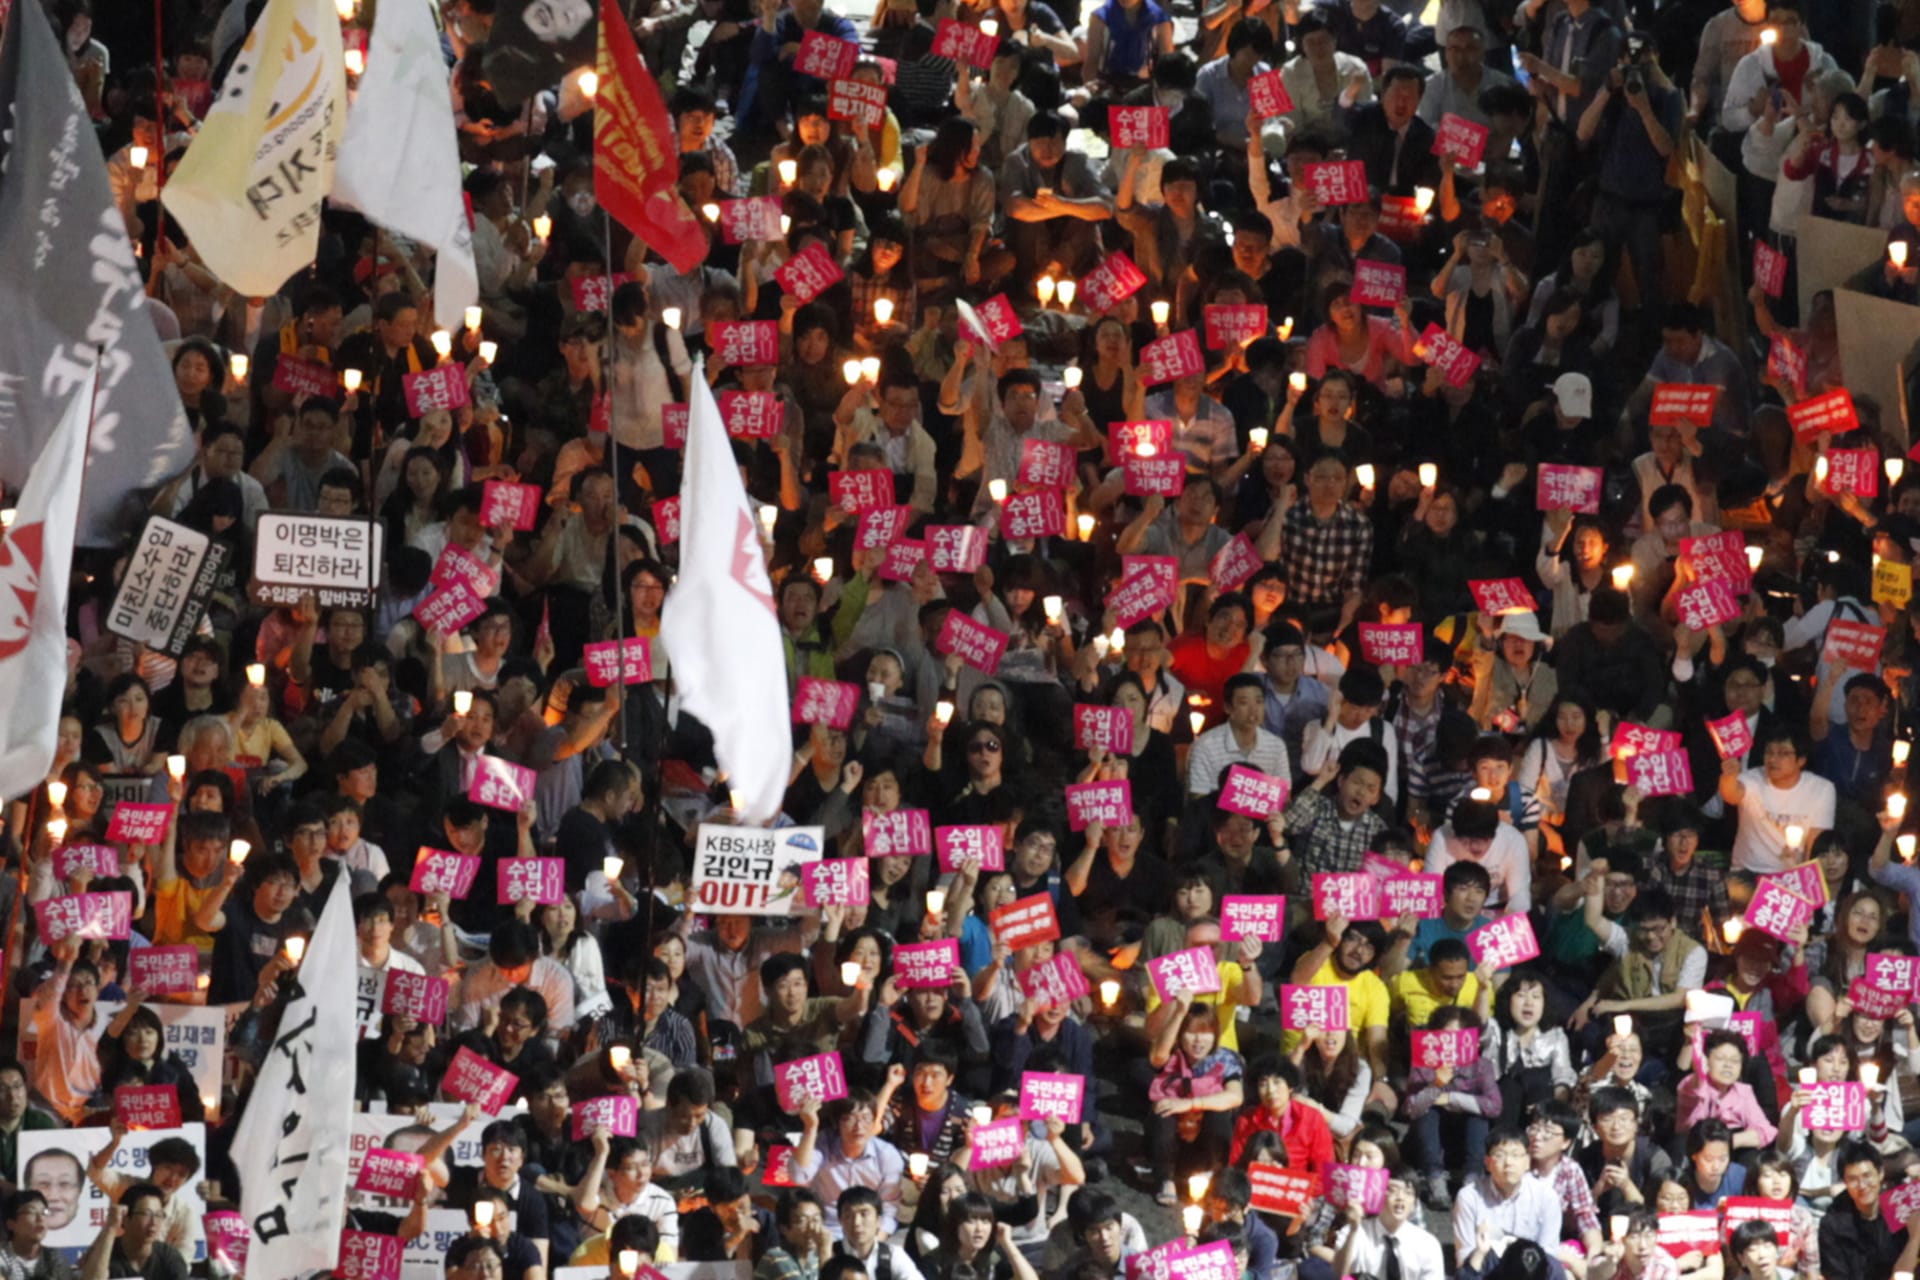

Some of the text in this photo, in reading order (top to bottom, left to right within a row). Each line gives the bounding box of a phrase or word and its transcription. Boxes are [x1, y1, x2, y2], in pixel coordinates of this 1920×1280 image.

[722, 324, 758, 345] 수입
[723, 345, 758, 363] 중단
[1147, 336, 1178, 361] 수입
[1151, 355, 1184, 380] 중단
[412, 372, 446, 392] 수입
[730, 394, 765, 415] 수입
[729, 415, 765, 434] 중단
[1031, 443, 1060, 464] 수입
[1832, 453, 1858, 473] 수입
[1030, 462, 1060, 486] 중단
[1129, 459, 1180, 474] 국민주권
[838, 473, 872, 495] 수입
[1135, 475, 1172, 490] 지켜요
[1006, 495, 1042, 517] 수입
[866, 509, 897, 530] 수입
[1010, 515, 1044, 537] 중단
[275, 523, 364, 551] 이명박은
[862, 527, 893, 548] 중단
[273, 555, 363, 580] 퇴진하라
[145, 545, 196, 631] 중단하라
[420, 583, 466, 620] 국민주권
[1679, 588, 1710, 612] 수입
[436, 599, 472, 631] 지켜요
[1684, 604, 1719, 630] 중단
[950, 619, 1000, 652] 국민주권
[1363, 629, 1416, 645] 국민주권
[948, 638, 986, 663] 지켜요
[1371, 645, 1409, 660] 지켜요
[1080, 709, 1111, 729] 수입
[1633, 752, 1668, 774] 수입
[1230, 773, 1282, 803] 국민주권
[1636, 772, 1671, 794] 중단
[1070, 785, 1122, 805] 국민주권
[1230, 792, 1269, 815] 지켜요
[117, 808, 167, 826] 국민주권
[1078, 803, 1117, 820] 지켜요
[119, 825, 154, 840] 지켜요
[872, 813, 909, 834] 수입
[873, 832, 910, 854] 중단
[946, 829, 983, 849] 수입
[427, 854, 461, 878] 수입
[506, 861, 542, 881] 수입
[703, 855, 774, 880] 김인규
[811, 862, 848, 884] 수입
[421, 873, 456, 893] 중단
[506, 879, 543, 900] 중단
[700, 880, 770, 908] OUT!
[812, 881, 849, 903] 중단
[1320, 877, 1356, 899] 수입
[1383, 880, 1436, 897] 국민주권
[44, 898, 79, 920] 수입
[1389, 897, 1428, 912] 지켜요
[1764, 886, 1797, 914] 수입
[1225, 903, 1278, 920] 국민주권
[1753, 906, 1790, 934] 중단
[1230, 921, 1269, 936] 지켜요
[1475, 921, 1510, 950] 수입
[135, 953, 190, 970] 국민주권
[897, 945, 952, 965] 국민주권
[905, 963, 948, 982] 지켜요
[1159, 954, 1194, 979] 수입
[1875, 957, 1912, 979] 수입
[144, 971, 185, 986] 지켜요
[394, 974, 428, 998] 수입
[1290, 988, 1326, 1009] 수입
[1291, 1008, 1327, 1029] 중단
[166, 1024, 216, 1045] 김재철
[1421, 1031, 1457, 1051] 수입
[456, 1055, 509, 1092] 국민주권
[784, 1060, 821, 1084] 수입
[121, 1092, 171, 1110] 국민주권
[453, 1075, 492, 1106] 지켜요
[788, 1078, 825, 1102] 중단
[1025, 1079, 1079, 1101] 국민주권
[1811, 1085, 1845, 1106] 수입
[1030, 1096, 1070, 1116] 지켜요
[1810, 1106, 1845, 1126] 중단
[128, 1110, 168, 1125] 지켜요
[974, 1125, 1018, 1147] 국민주권
[978, 1144, 1013, 1163] 지켜요
[366, 1157, 418, 1180] 국민주권
[1331, 1166, 1366, 1189] 수입
[367, 1173, 404, 1191] 지켜요
[346, 1236, 383, 1258] 수입
[1169, 1248, 1229, 1273] 국민주권
